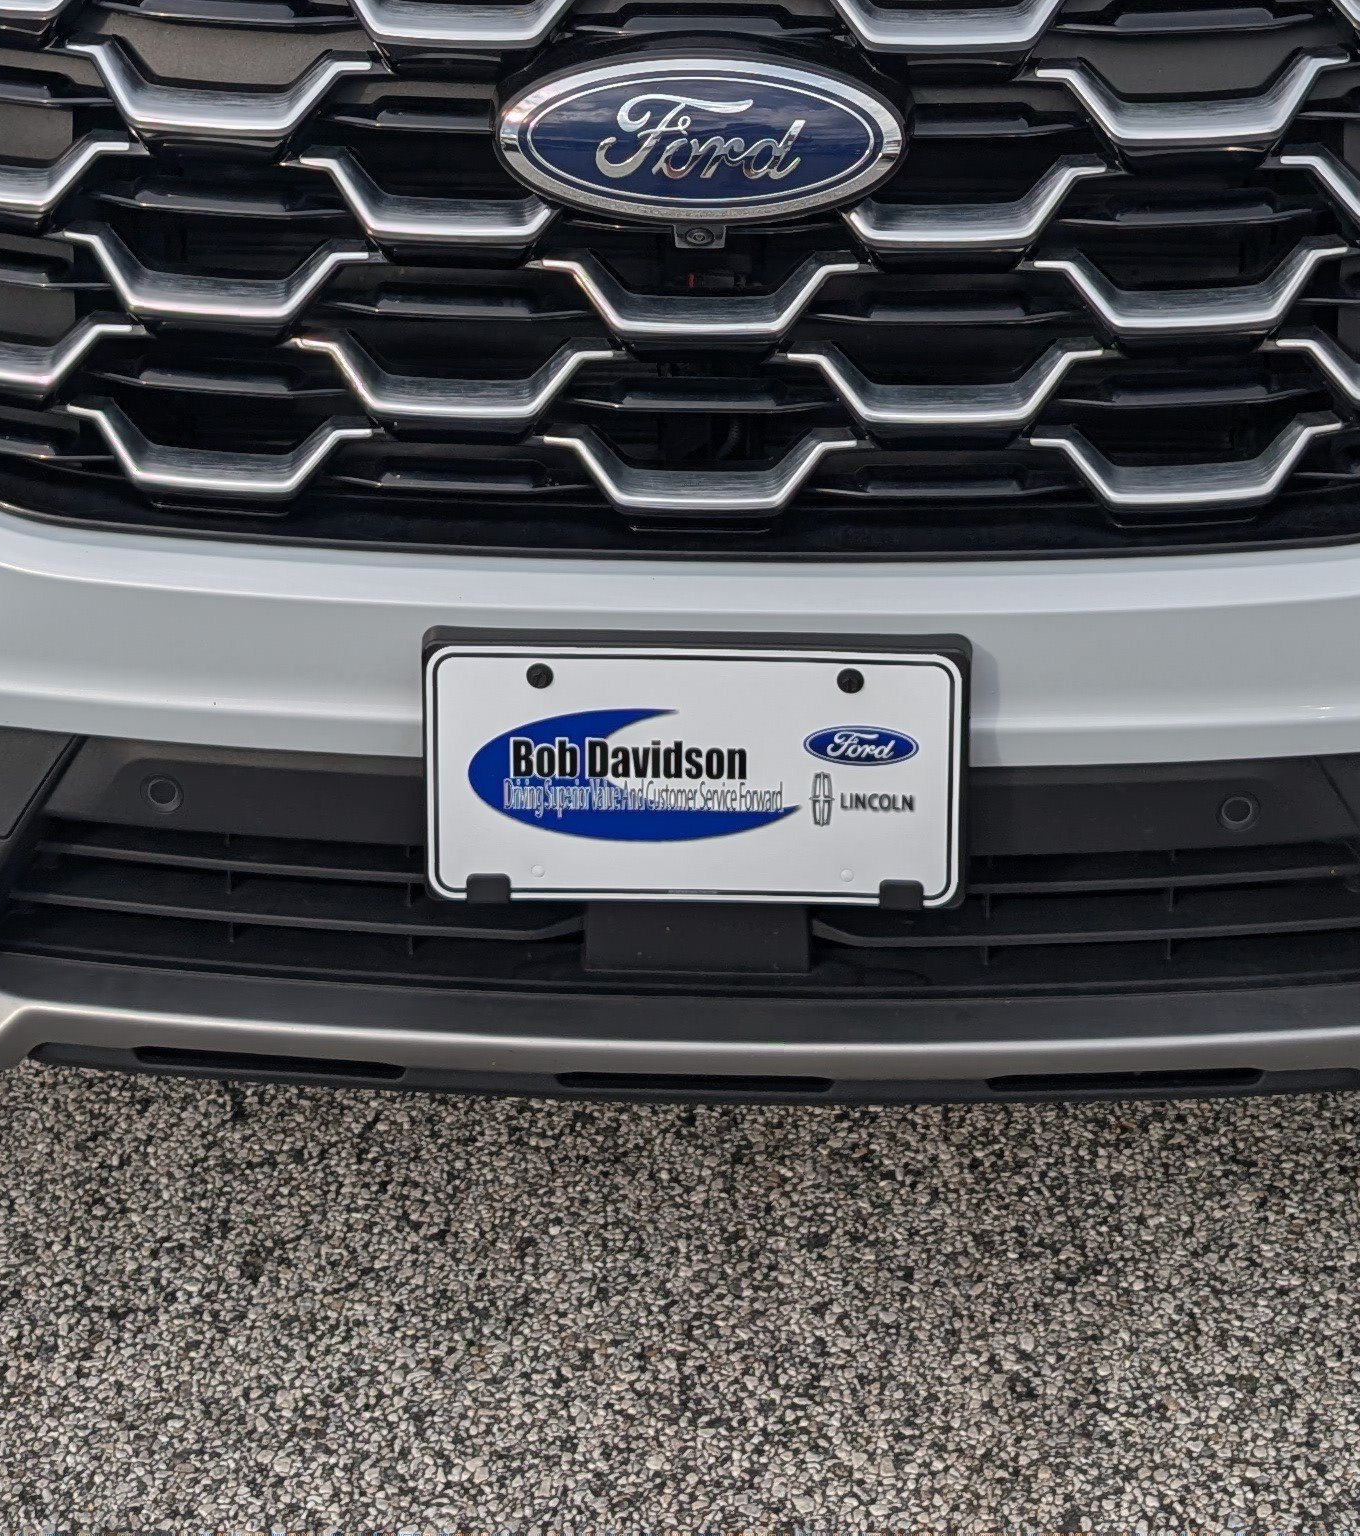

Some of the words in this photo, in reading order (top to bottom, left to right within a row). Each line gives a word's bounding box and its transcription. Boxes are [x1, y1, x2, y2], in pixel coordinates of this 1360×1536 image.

[595, 93, 806, 179] Ford
[511, 737, 579, 778] Bob
[587, 738, 748, 780] Davidson
[826, 731, 896, 759] Ford
[503, 778, 545, 818] Driving
[544, 778, 590, 818] Superior
[589, 779, 621, 811] Value
[620, 779, 645, 811] And
[646, 780, 697, 811] Customer
[699, 780, 738, 812] Service
[739, 781, 783, 813] Forward
[840, 792, 915, 812] LINCOLN
